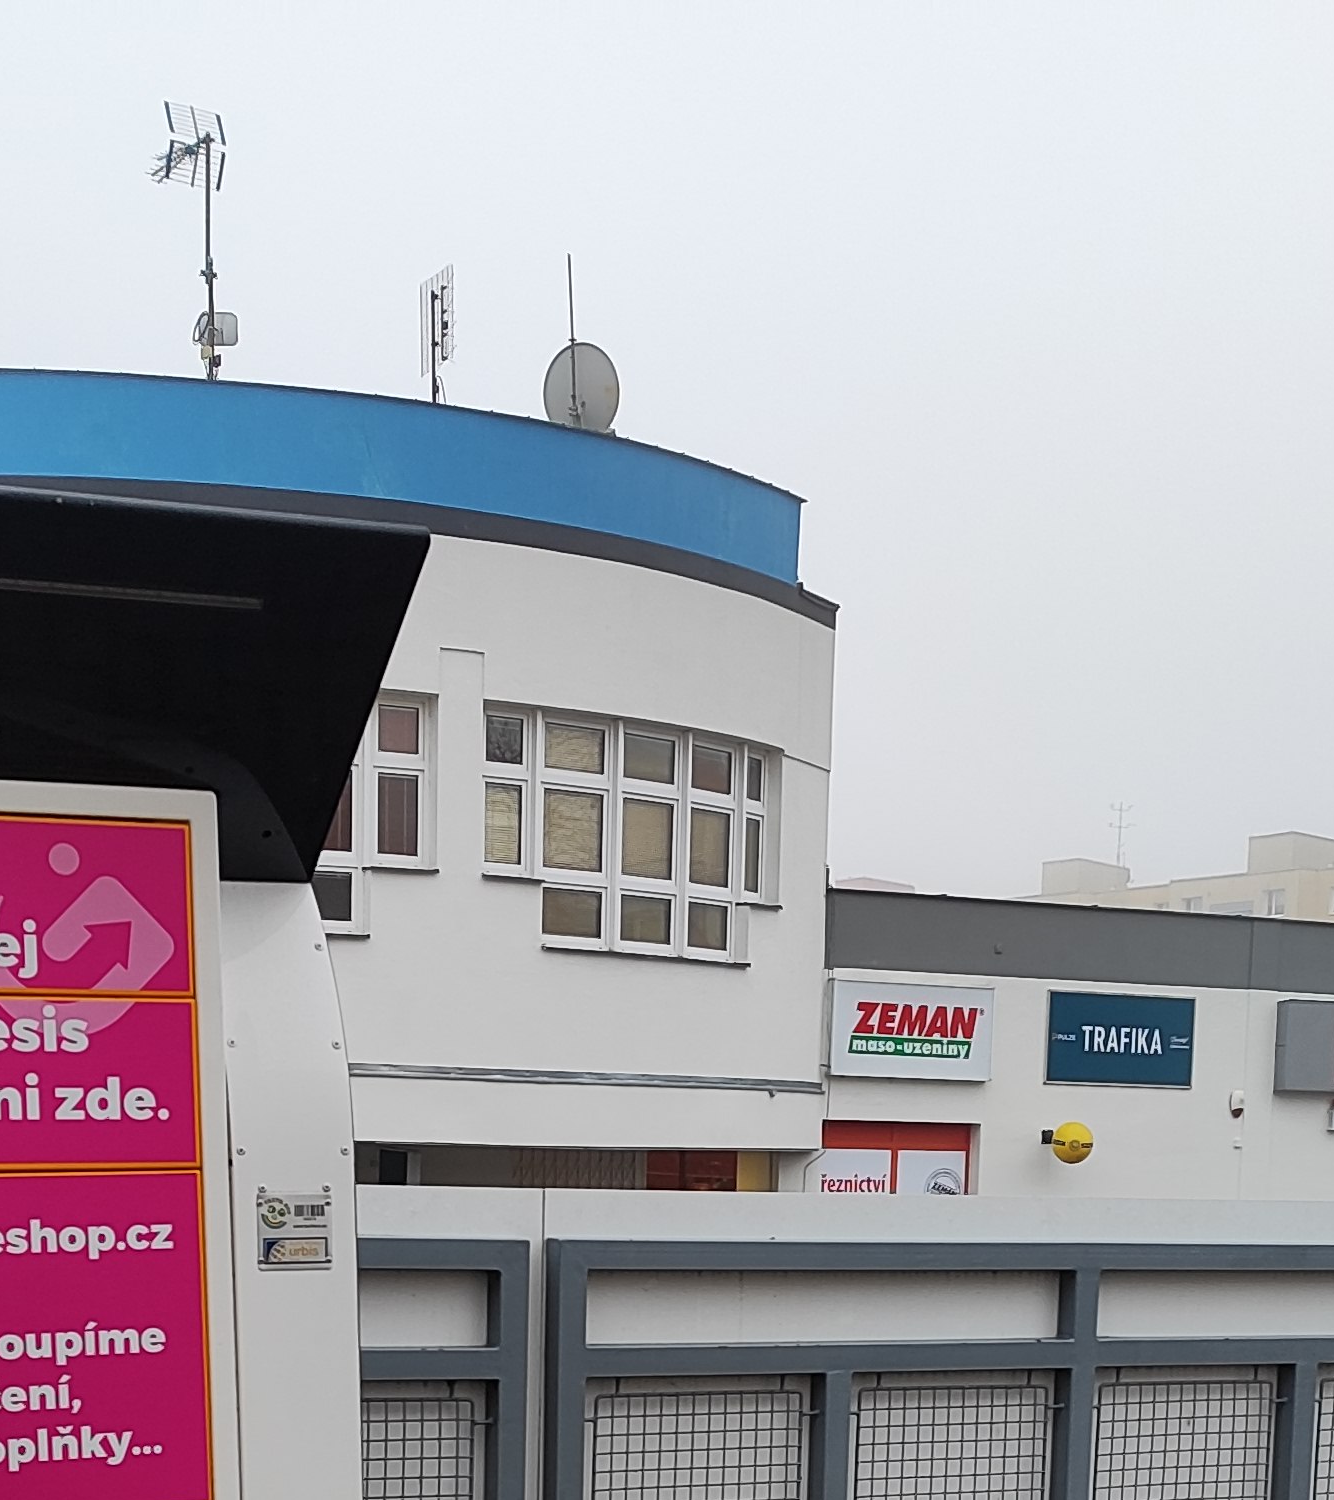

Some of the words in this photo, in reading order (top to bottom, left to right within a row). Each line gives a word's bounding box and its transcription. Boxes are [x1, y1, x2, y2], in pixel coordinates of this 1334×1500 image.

[852, 1002, 978, 1039] ZEMAN
[1081, 1025, 1163, 1055] TRAFIKA
[54, 1076, 170, 1120] zde.
